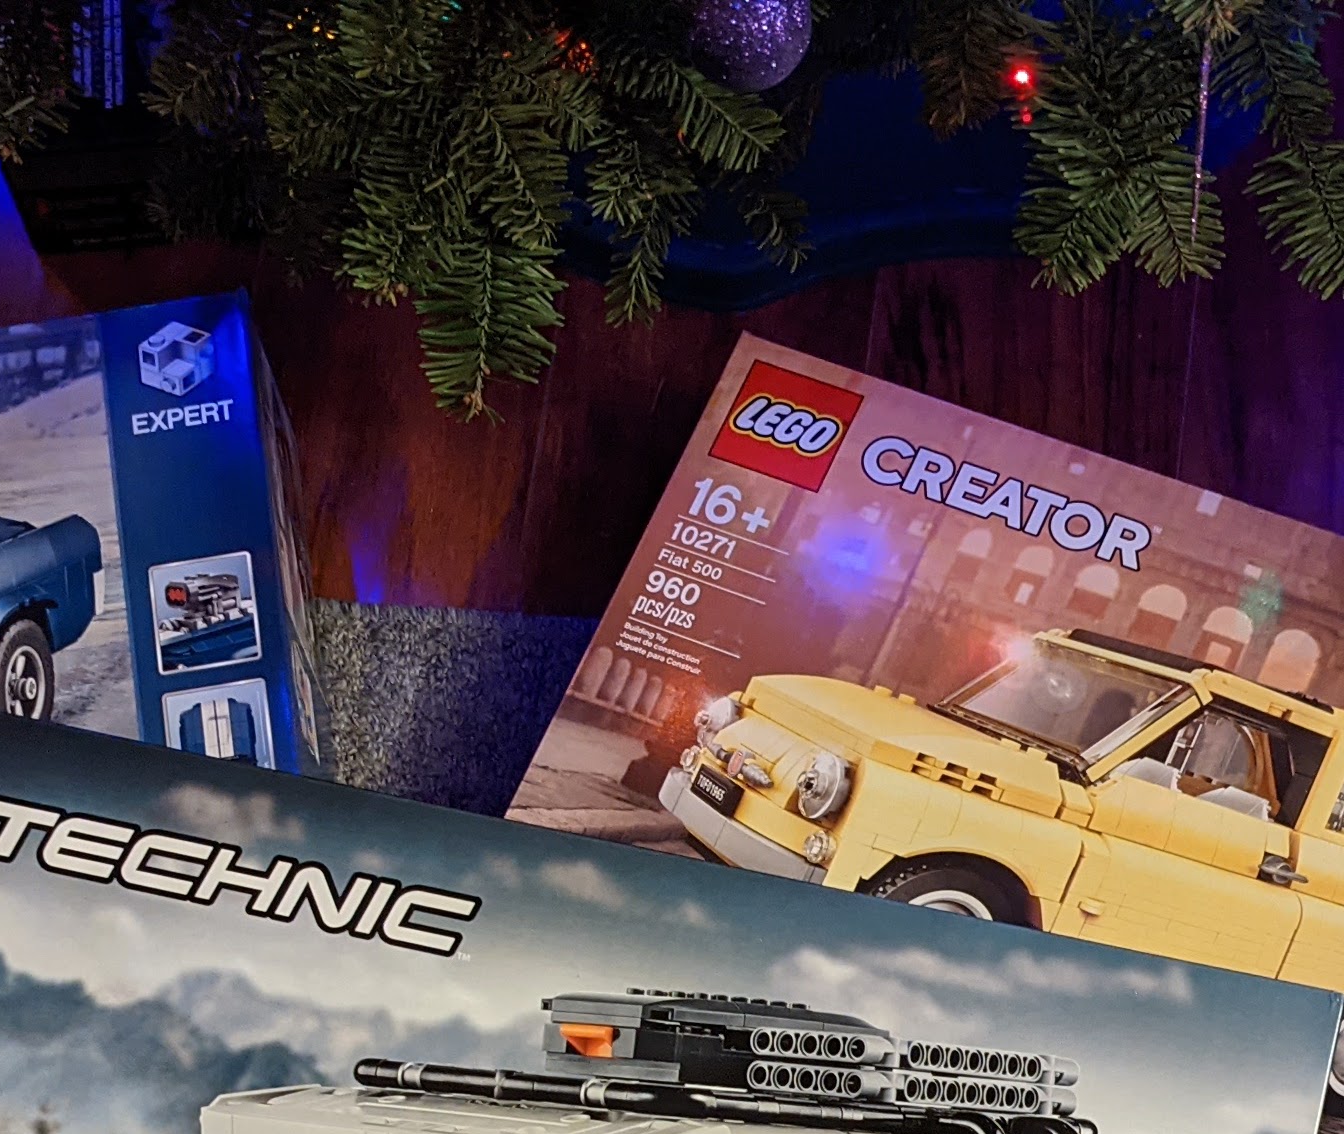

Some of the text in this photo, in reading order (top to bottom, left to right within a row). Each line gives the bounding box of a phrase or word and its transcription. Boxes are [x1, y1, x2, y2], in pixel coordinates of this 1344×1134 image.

[131, 398, 234, 436] EXPERT
[732, 395, 841, 455] LEGO
[688, 477, 771, 534] 16+
[860, 435, 1152, 572] CREATOR
[671, 521, 736, 560] 10271
[657, 548, 722, 580] Fiat 500
[645, 570, 701, 606] 960
[632, 595, 696, 629] pcs/pzs
